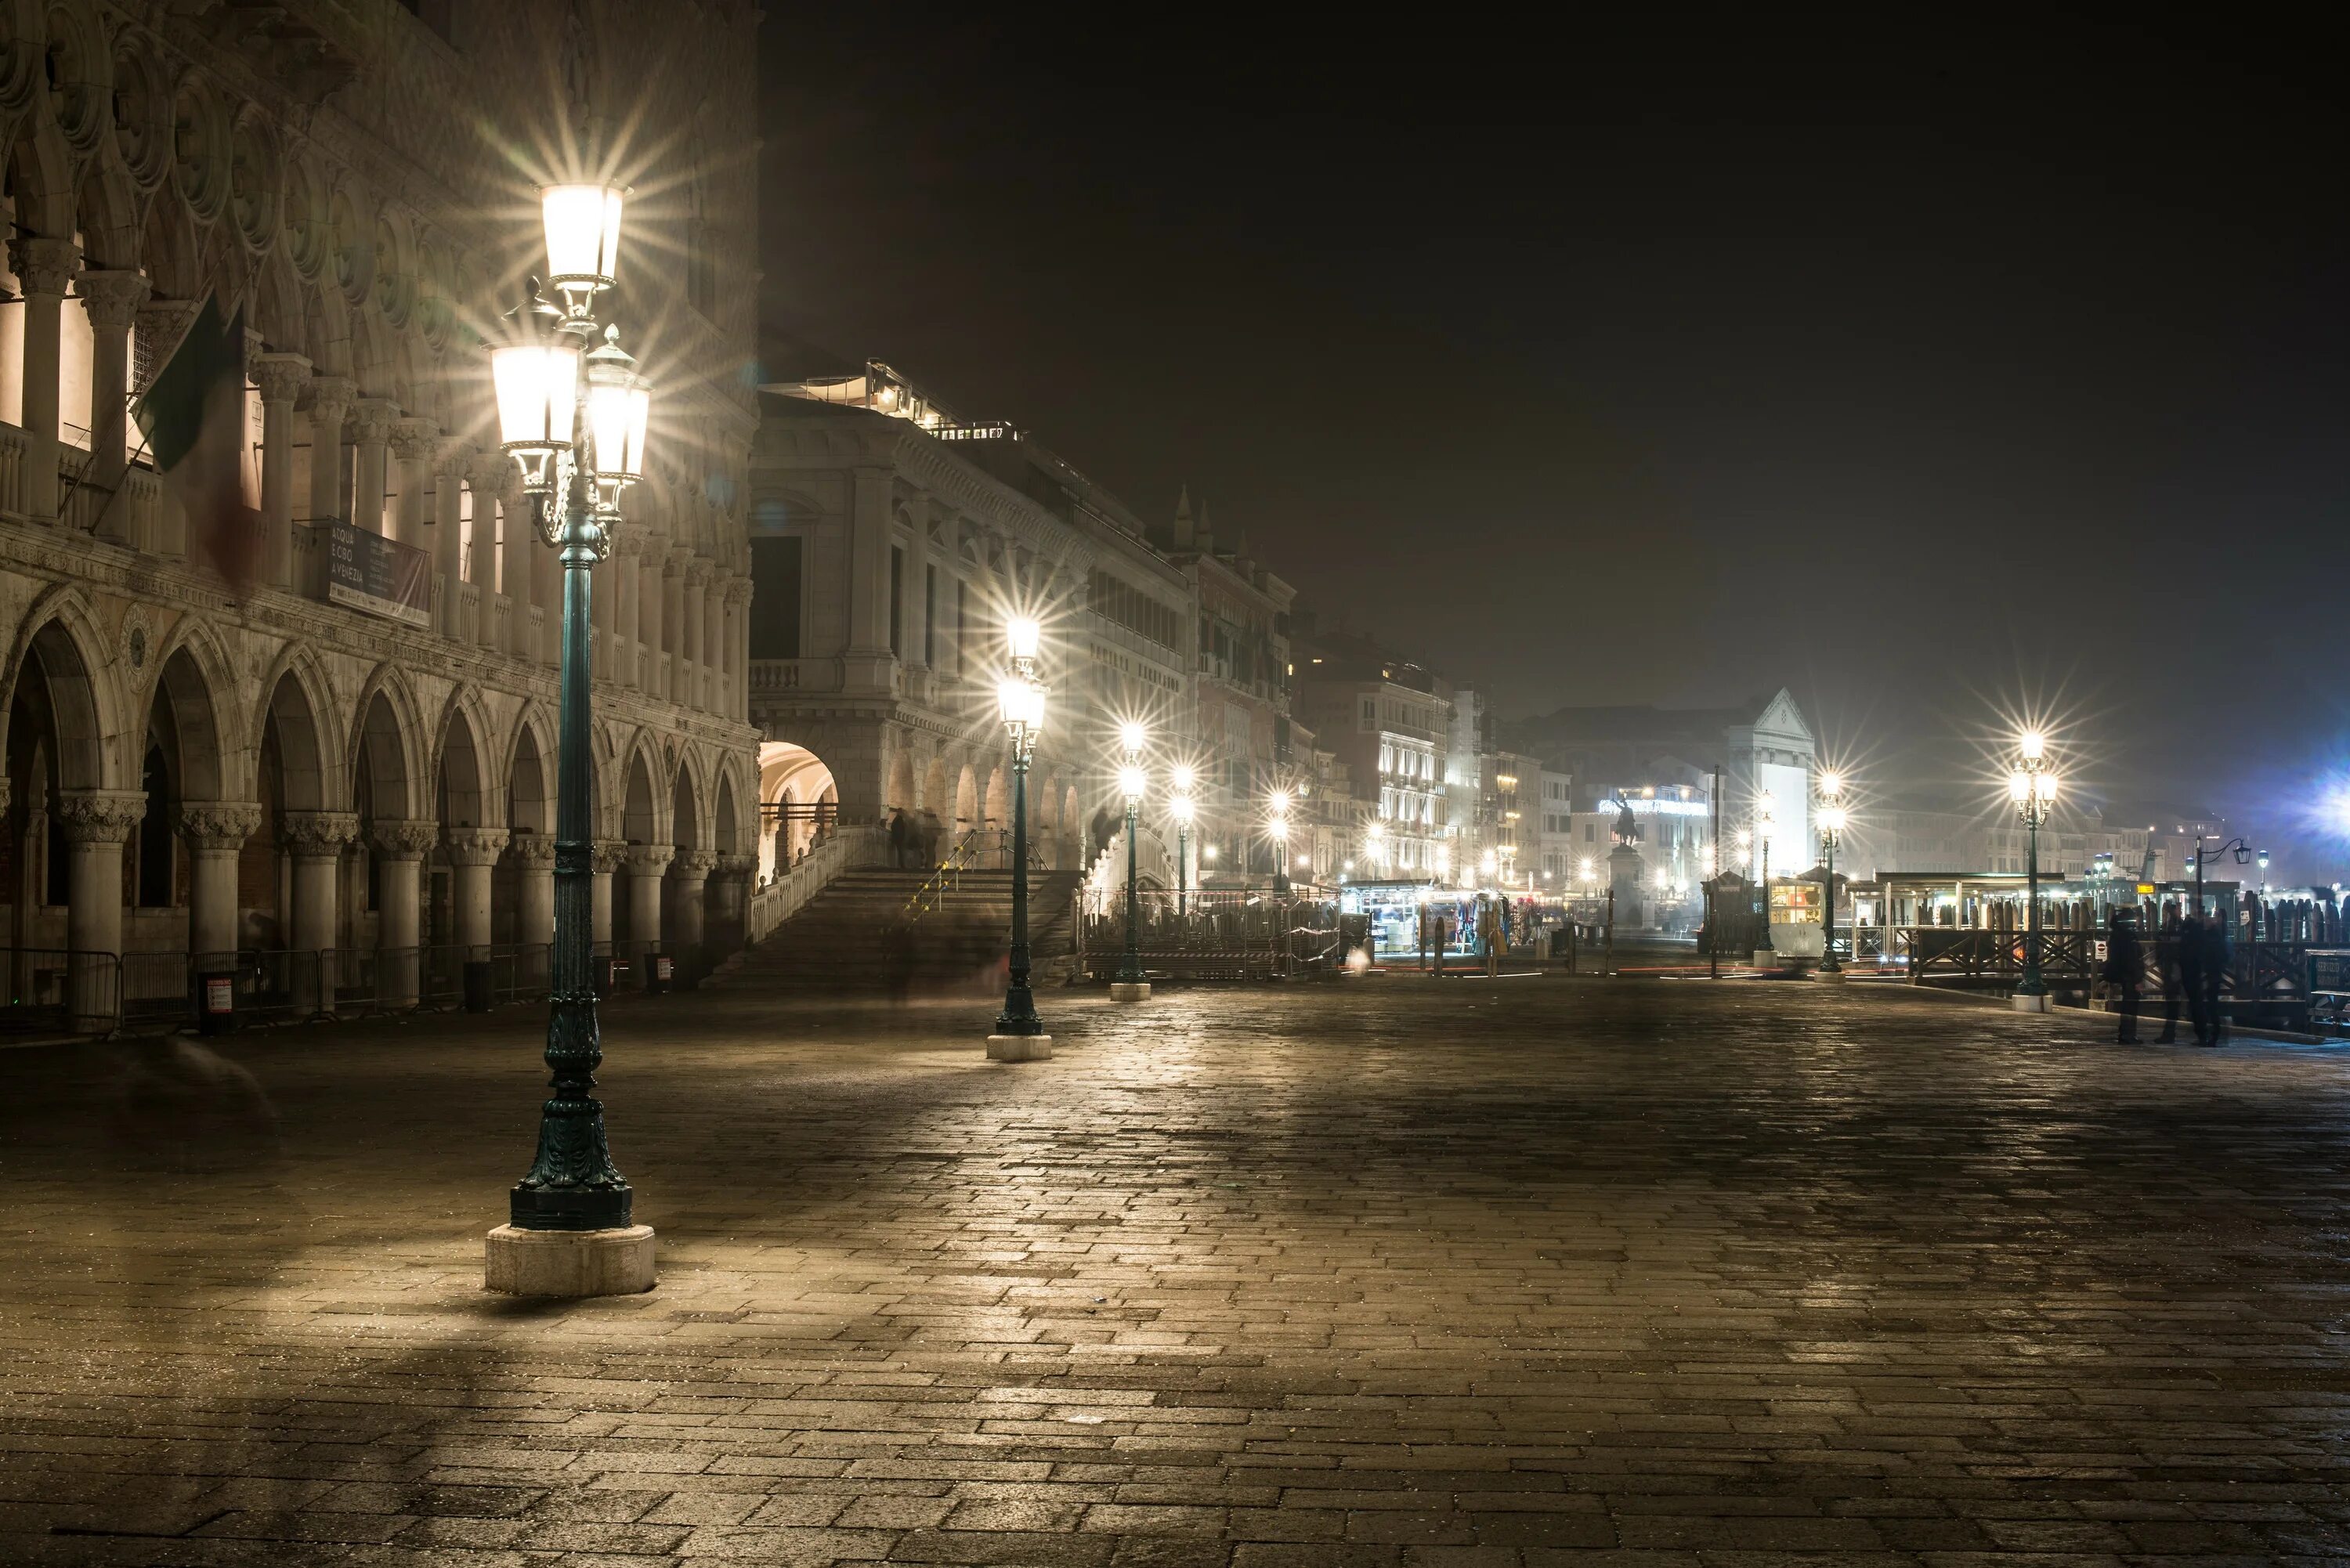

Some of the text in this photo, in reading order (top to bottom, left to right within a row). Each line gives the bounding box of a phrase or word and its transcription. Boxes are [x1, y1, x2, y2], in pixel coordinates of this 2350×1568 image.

[332, 527, 353, 546] ACQUA
[332, 544, 336, 557] E
[332, 562, 337, 574] A
[337, 562, 363, 583] VENEZIA
